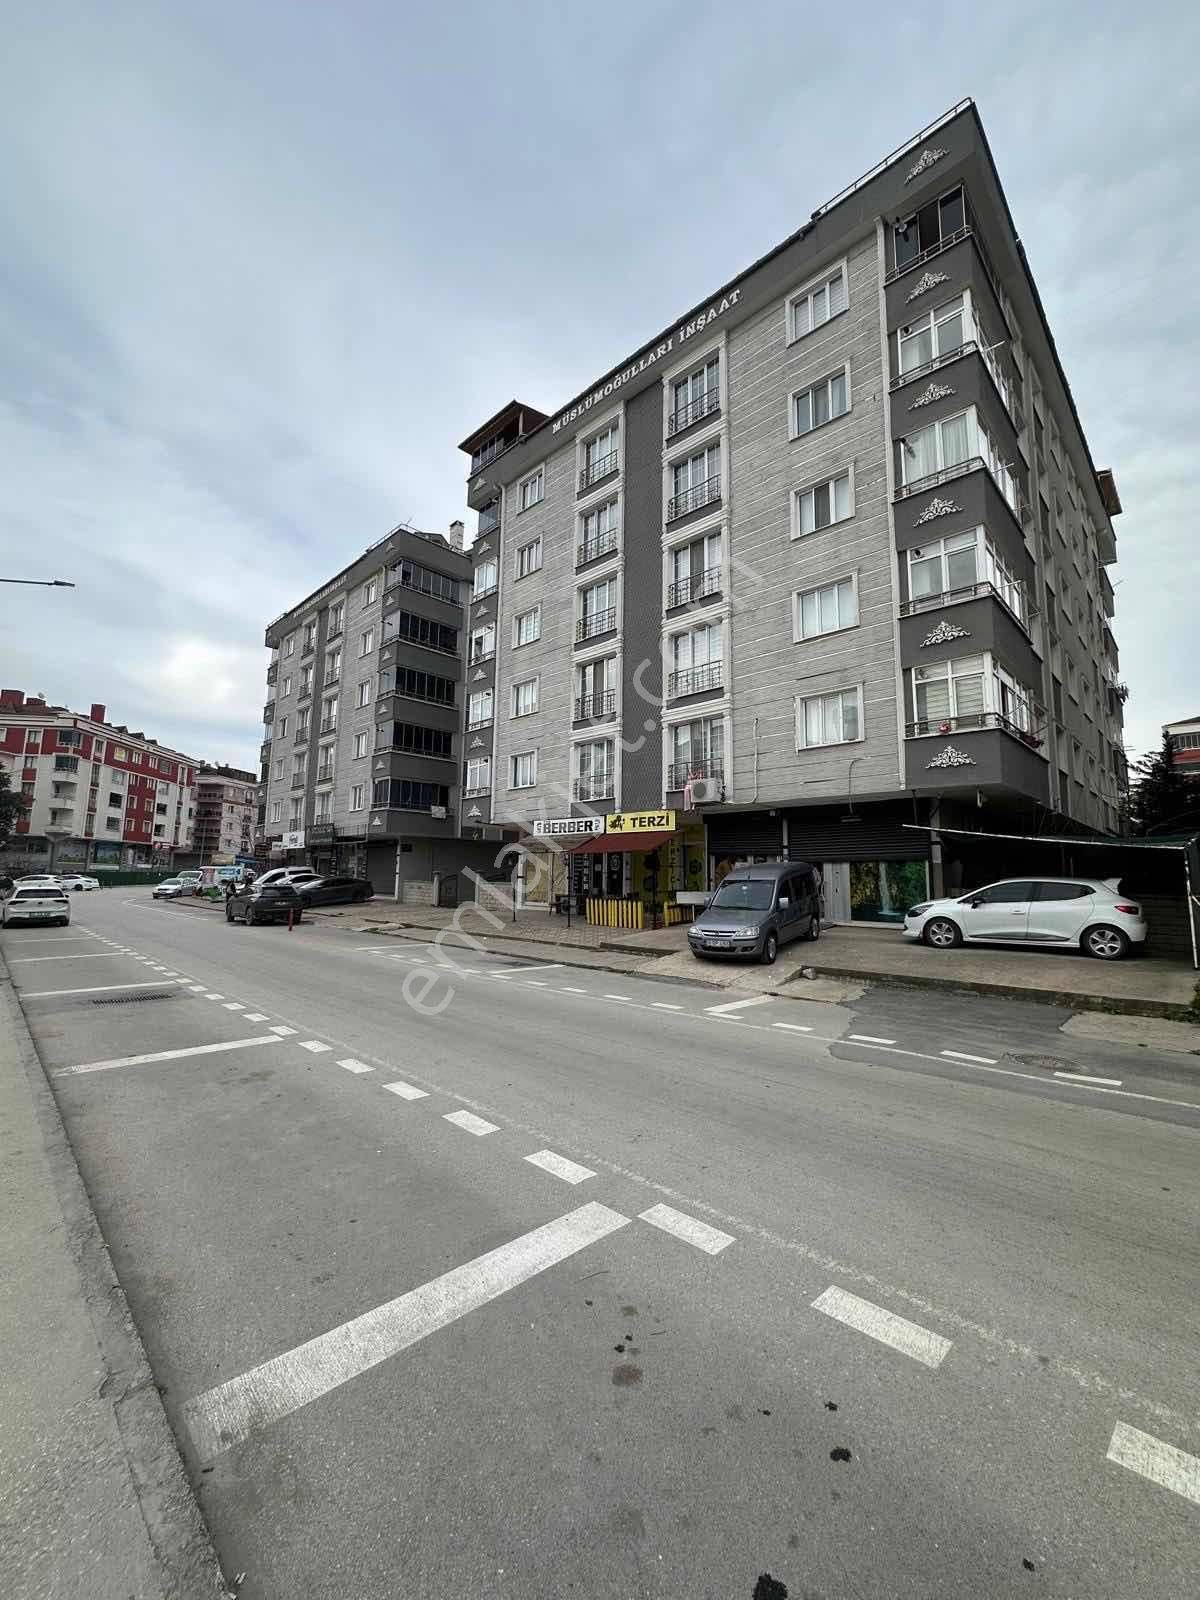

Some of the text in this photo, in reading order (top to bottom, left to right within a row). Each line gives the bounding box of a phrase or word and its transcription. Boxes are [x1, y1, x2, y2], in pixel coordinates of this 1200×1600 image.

[552, 289, 741, 434] MÜSLÜMOĞULLARI İNŞAAT
[543, 820, 593, 834] BERBER
[630, 812, 669, 828] TERZİ
